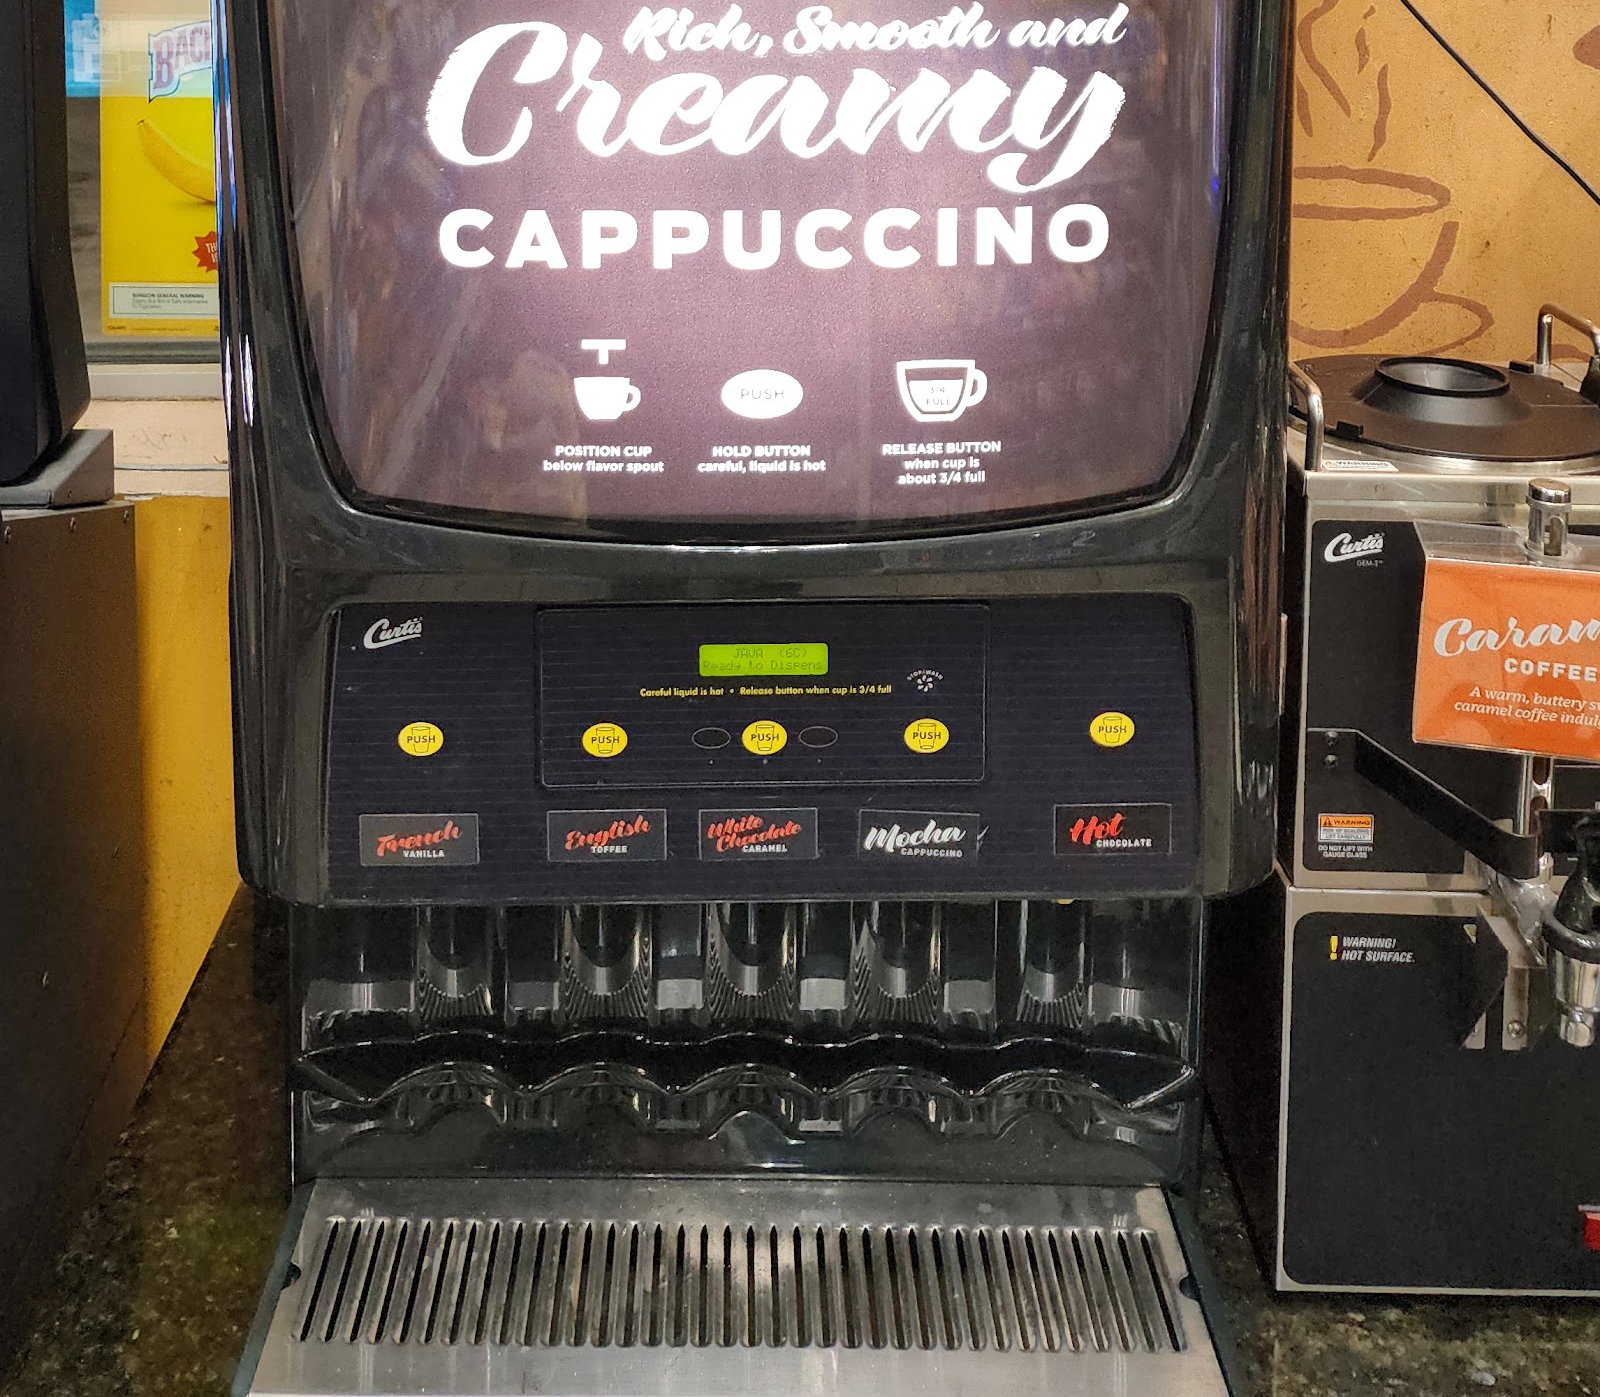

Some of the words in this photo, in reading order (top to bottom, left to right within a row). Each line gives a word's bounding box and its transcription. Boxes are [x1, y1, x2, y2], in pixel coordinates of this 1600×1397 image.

[622, 4, 772, 60] Rich,
[783, 1, 1001, 55] Smooth
[1008, 1, 1130, 47] and
[425, 20, 1127, 193] Creamy
[438, 202, 1111, 270] CAPPUCCINO
[740, 388, 785, 400] PUSH
[555, 445, 621, 457] POSITION
[623, 445, 652, 457] CUP
[712, 445, 752, 457] HOLD
[754, 445, 811, 456] BUTTON
[882, 443, 944, 455] RELEASE
[945, 441, 1002, 454] BUTTON
[543, 459, 583, 472] below
[586, 459, 624, 472] flavor
[626, 460, 664, 473] spout
[697, 460, 746, 473] careful,
[749, 460, 786, 473] liquid
[789, 460, 801, 471] is
[803, 459, 826, 471] hot
[904, 458, 939, 470] when
[942, 458, 966, 470] cup
[969, 456, 980, 468] is
[897, 473, 937, 485] about
[939, 472, 962, 485] 3/4
[965, 471, 986, 483] full
[1324, 532, 1384, 562] Curtis
[364, 617, 423, 649] Curtis
[733, 648, 764, 659] JAVA
[703, 660, 741, 671] Ready
[749, 660, 764, 670] to
[771, 660, 823, 671] Dispens
[1504, 657, 1598, 682] COFFEE
[640, 687, 671, 697] Careful
[673, 687, 698, 698] liquid
[700, 687, 707, 696] is
[709, 687, 724, 696] hot
[739, 686, 773, 696] Release
[775, 686, 803, 695] button
[805, 685, 830, 695] when
[831, 686, 847, 697] cup
[849, 685, 857, 694] is
[859, 684, 876, 694] 3/4
[877, 684, 892, 694] full
[1469, 686, 1481, 698] A
[1485, 688, 1529, 704] warm,
[1533, 692, 1587, 712] buttery
[1454, 701, 1512, 716] caramel
[1515, 708, 1558, 722] coffee
[912, 731, 941, 740] PUSH
[1098, 725, 1127, 733] PUSH
[407, 734, 436, 744] PUSH
[591, 735, 620, 744] PUSH
[750, 733, 779, 742] PUSH
[565, 814, 650, 850] English
[707, 814, 763, 839] White
[1070, 813, 1127, 845] Hot
[716, 820, 802, 852] Chocolate
[864, 818, 967, 853] Mocha
[1096, 838, 1152, 847] CHOCOLATE
[403, 849, 445, 858] VANILLA
[590, 845, 628, 854] TOFFEE
[742, 844, 788, 853] CARAMEL
[901, 848, 963, 858] CAPPUCCINO
[1343, 936, 1396, 948] WARNING!
[1341, 950, 1364, 961] HOT
[1365, 951, 1415, 962] SURFACE.
